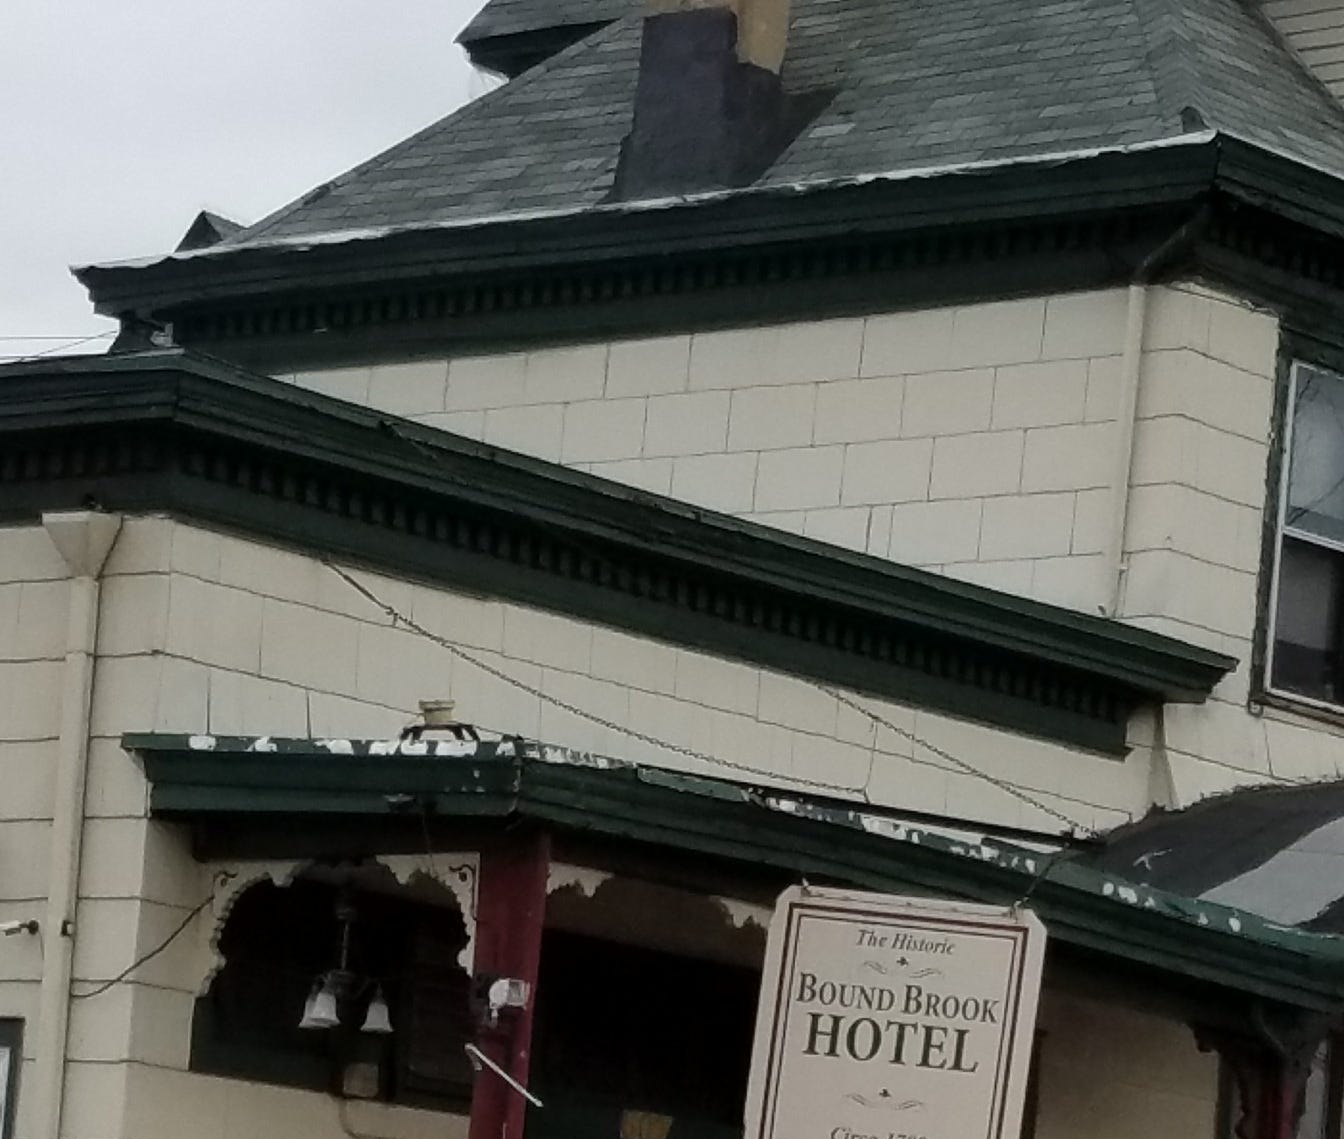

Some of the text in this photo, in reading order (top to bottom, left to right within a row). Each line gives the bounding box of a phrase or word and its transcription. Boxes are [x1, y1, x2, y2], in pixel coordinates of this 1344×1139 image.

[856, 928, 955, 956] The Historic
[796, 971, 1000, 1024] BOUND BROOK
[802, 1012, 979, 1073] HOTEL
